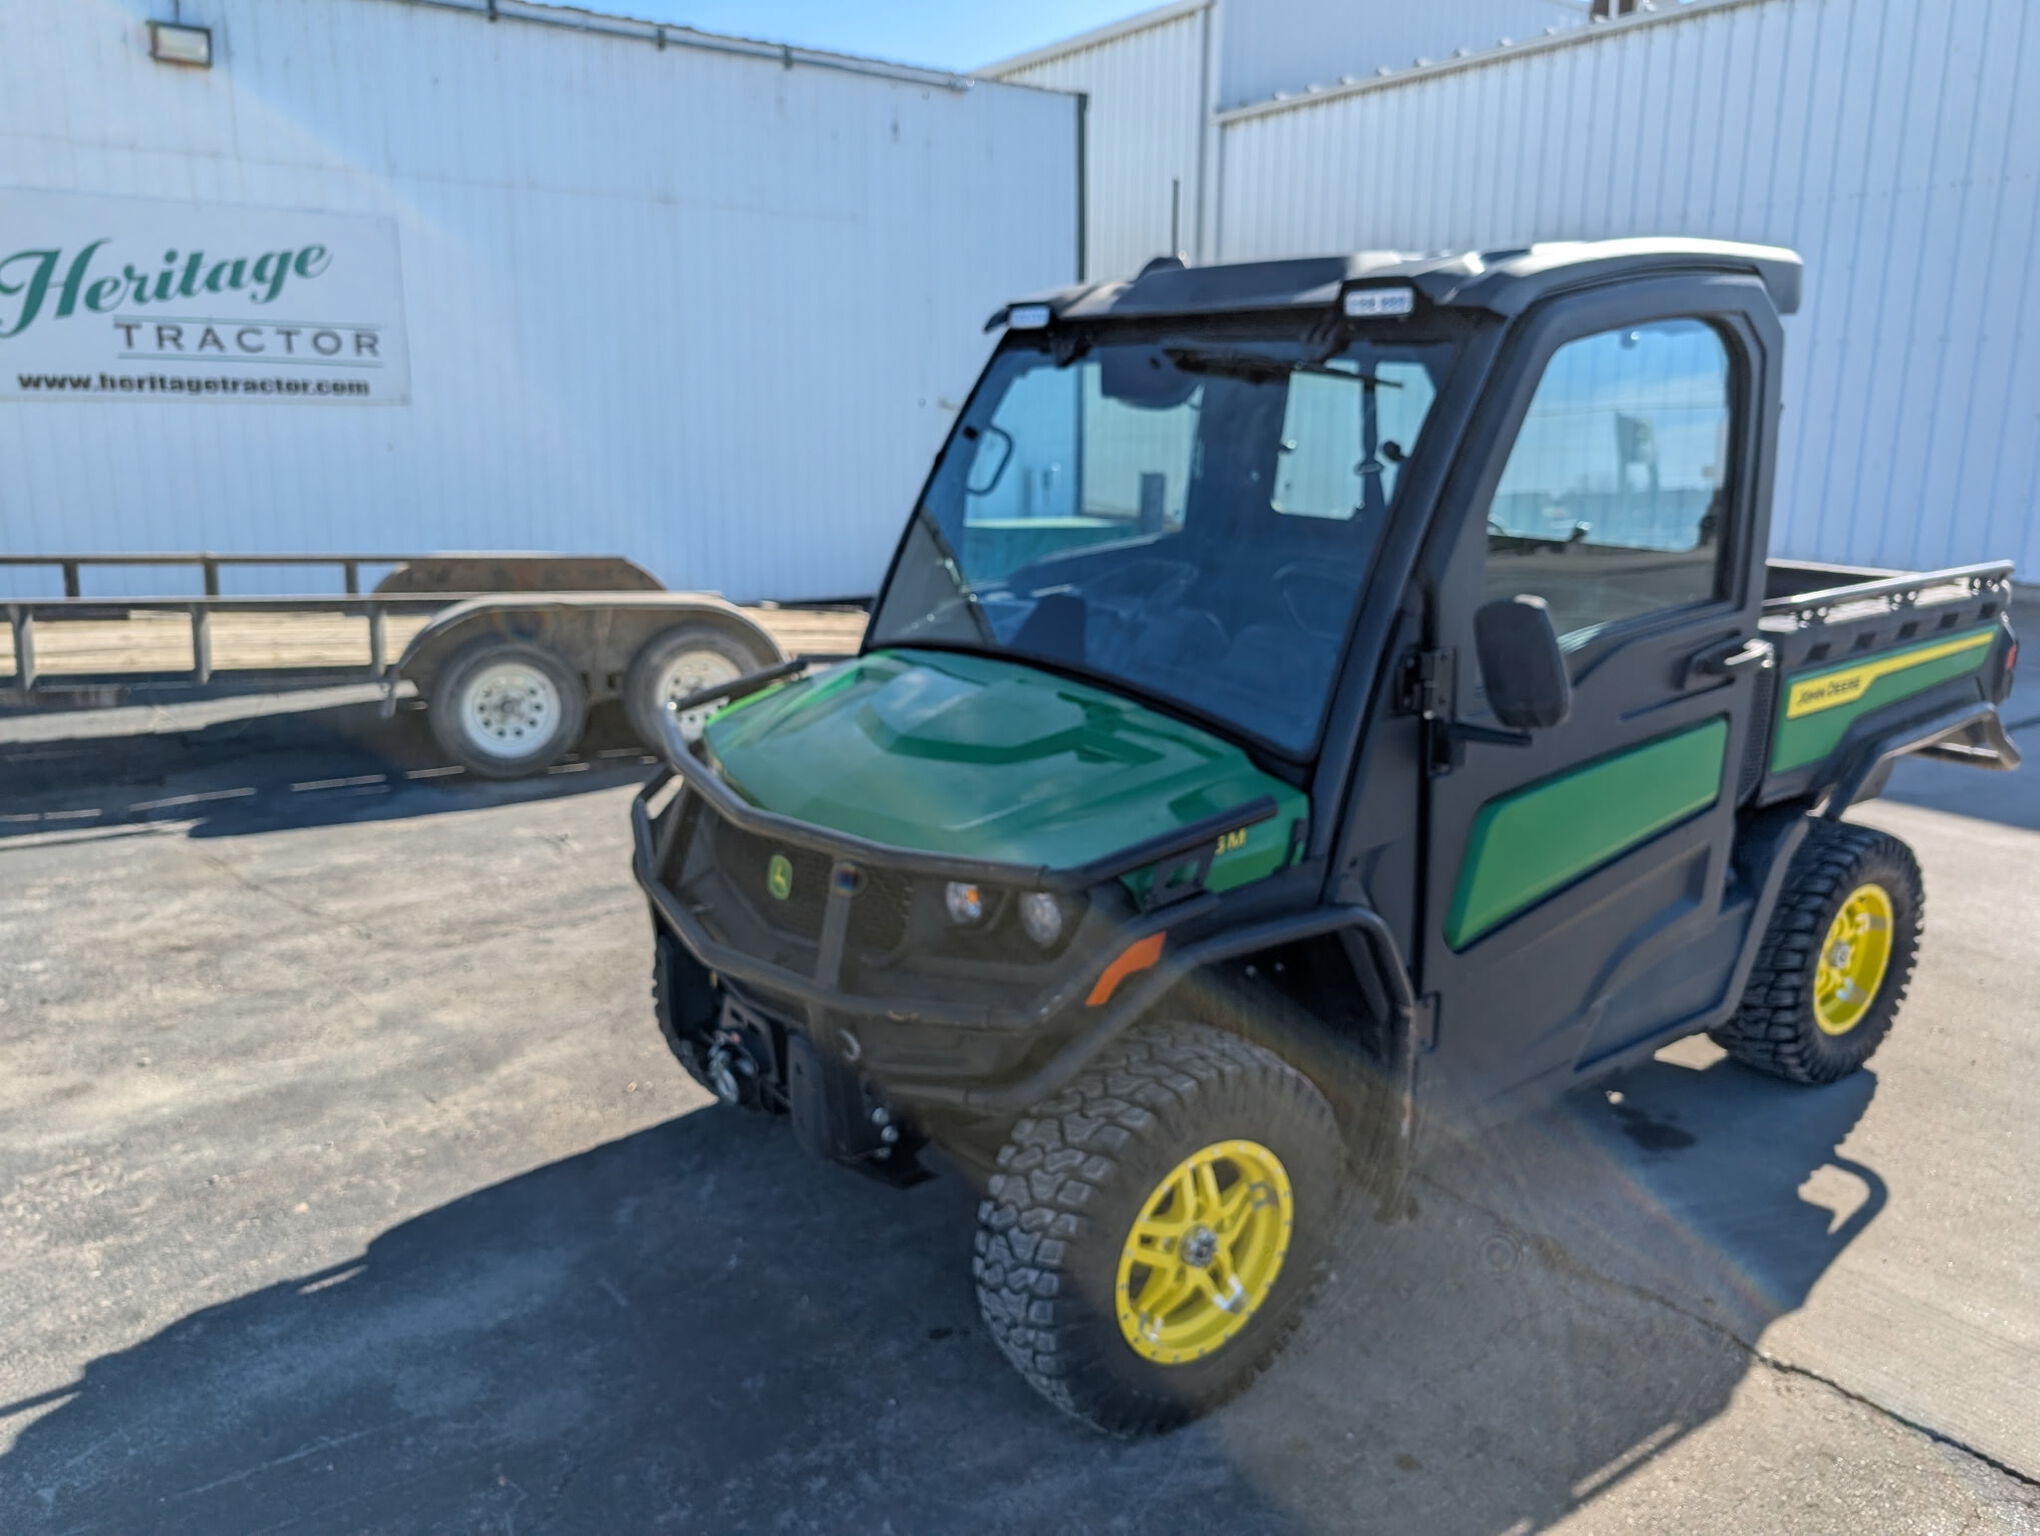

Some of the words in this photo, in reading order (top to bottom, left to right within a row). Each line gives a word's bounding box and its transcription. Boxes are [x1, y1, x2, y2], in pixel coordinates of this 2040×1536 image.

[0, 237, 333, 339] Heritage
[114, 321, 382, 357] TRACTOR
[17, 373, 371, 396] www.heritagetractor.com
